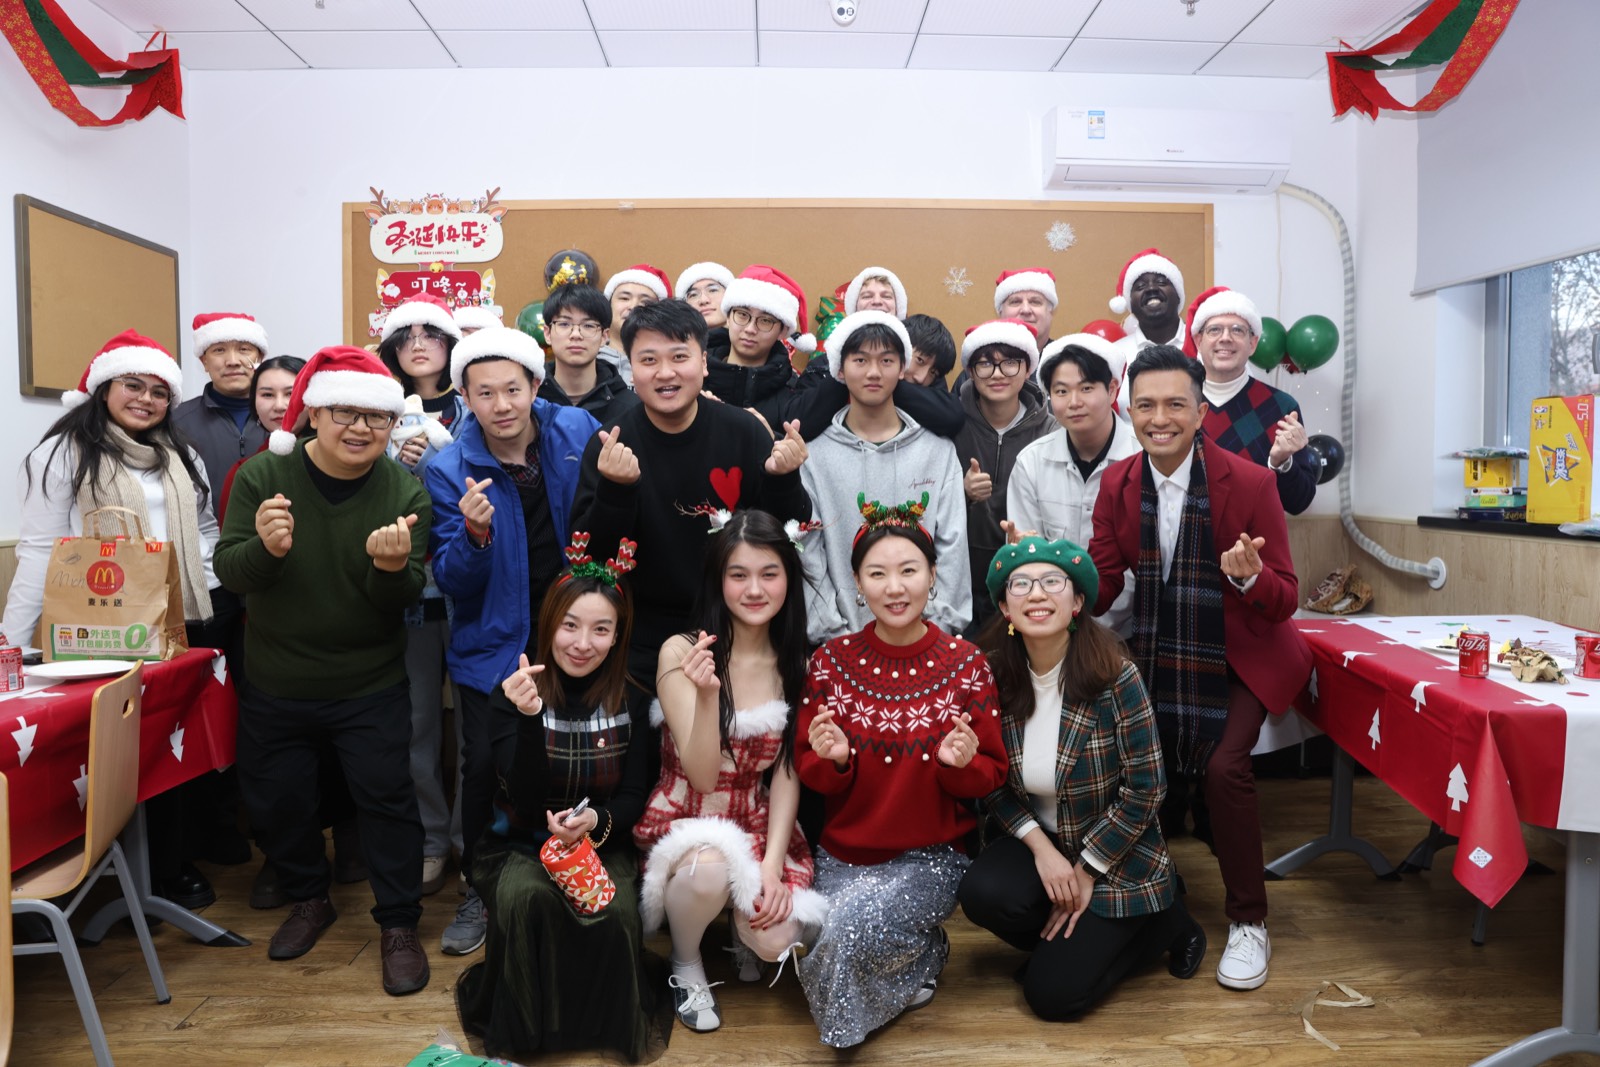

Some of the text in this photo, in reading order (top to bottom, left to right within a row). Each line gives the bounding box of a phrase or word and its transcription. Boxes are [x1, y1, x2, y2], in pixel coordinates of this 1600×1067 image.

[385, 220, 488, 254] 圣诞快乐
[88, 597, 123, 607] 麦乐送
